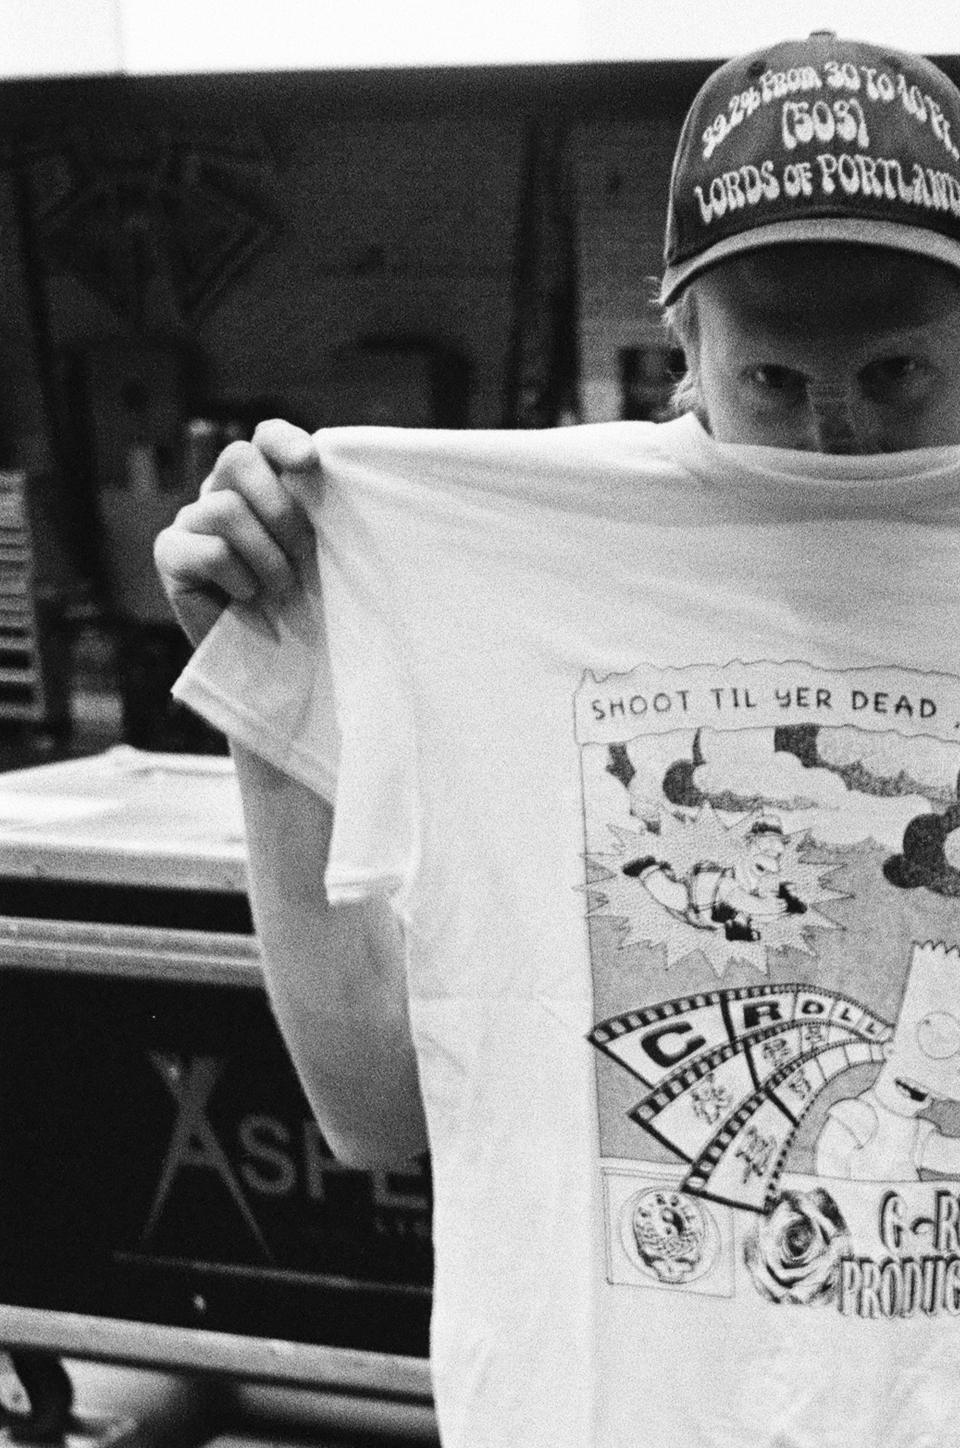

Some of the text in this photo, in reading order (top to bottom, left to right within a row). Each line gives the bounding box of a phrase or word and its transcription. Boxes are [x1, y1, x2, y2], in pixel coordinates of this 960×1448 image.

[758, 65, 822, 102] FROM
[823, 61, 861, 92] 30
[861, 65, 895, 101] TO
[782, 98, 869, 149] (503)
[694, 160, 780, 224] LORDS
[784, 162, 813, 197] OF
[591, 689, 690, 721] SHOOT
[709, 687, 757, 710] TIL
[774, 686, 832, 709] YER
